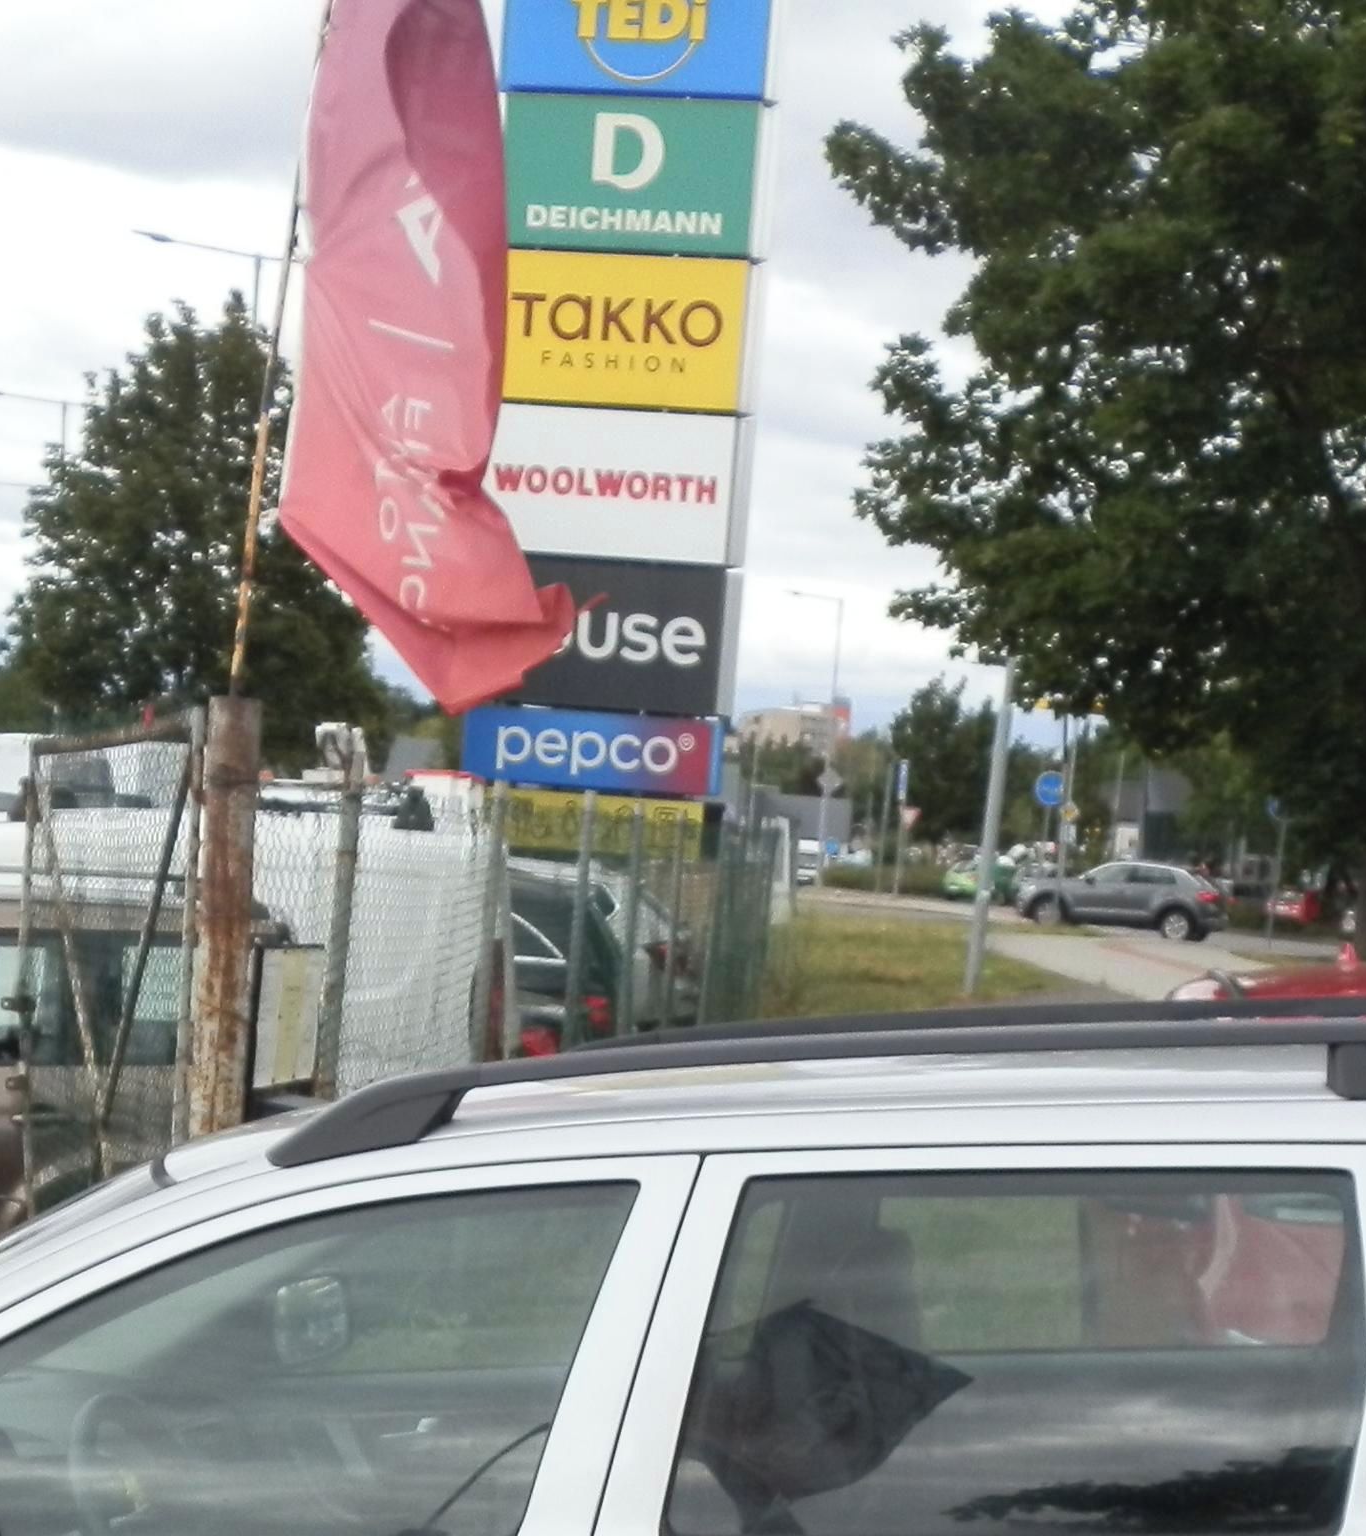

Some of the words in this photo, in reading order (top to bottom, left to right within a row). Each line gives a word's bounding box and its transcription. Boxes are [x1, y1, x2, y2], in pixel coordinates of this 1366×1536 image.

[591, 112, 665, 190] D
[525, 203, 723, 236] DEICHMANN
[540, 350, 686, 374] FASHION
[493, 463, 718, 505] WOOLWORTH
[554, 610, 707, 665] use
[495, 725, 679, 776] pepco
